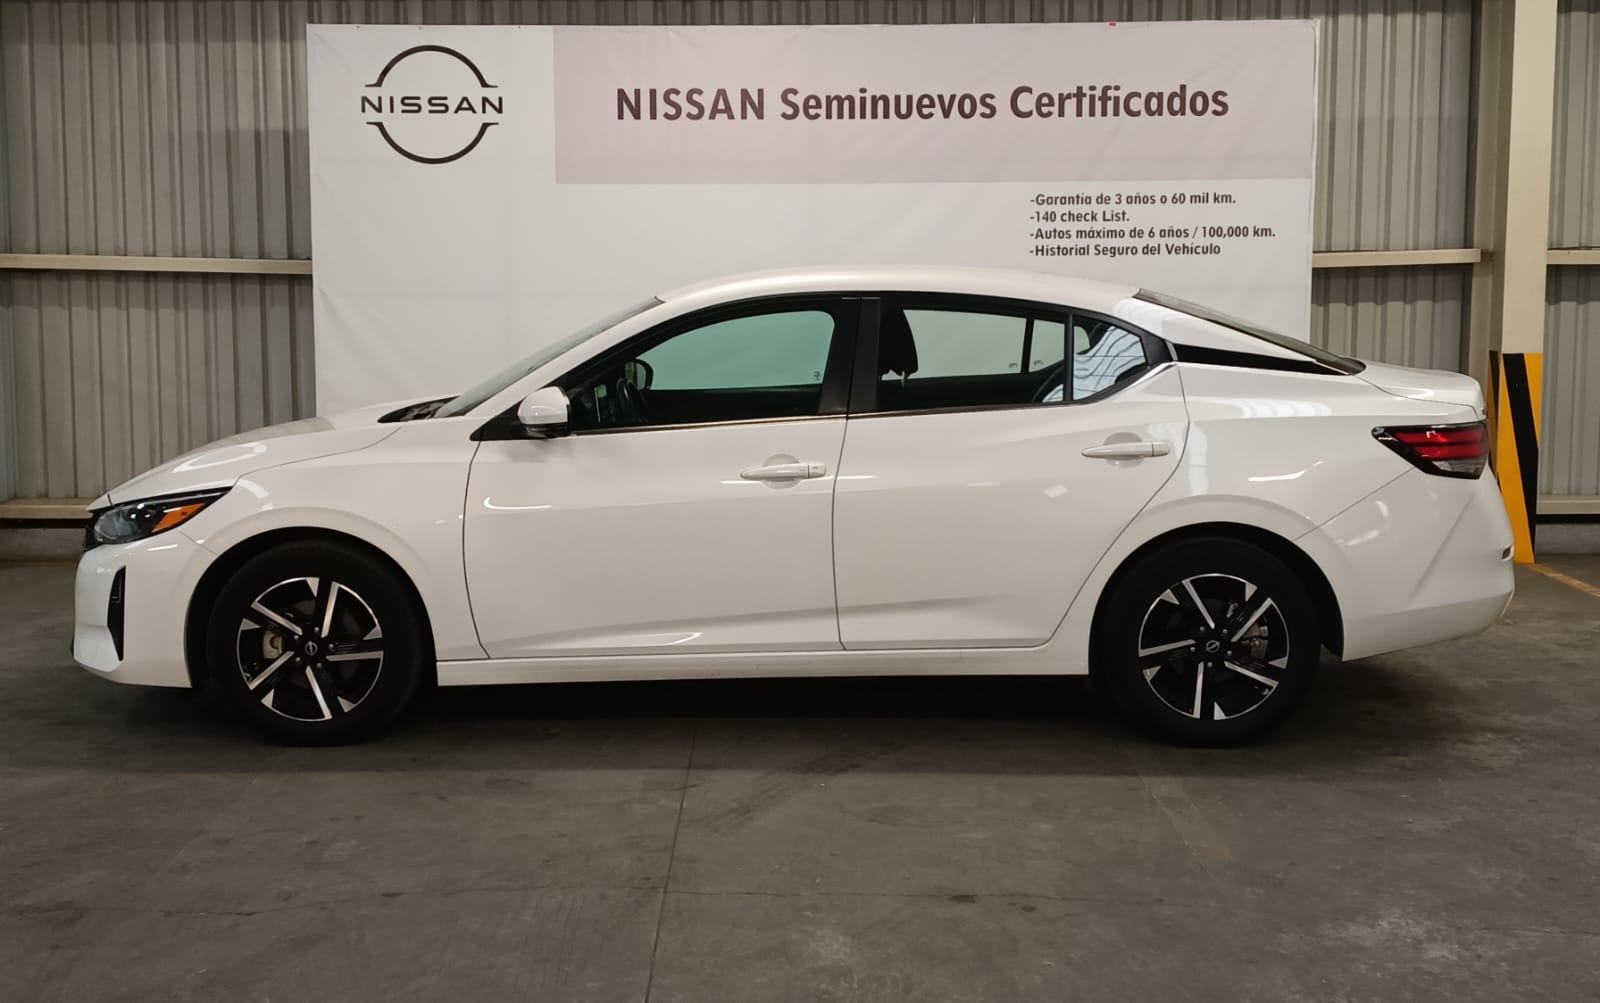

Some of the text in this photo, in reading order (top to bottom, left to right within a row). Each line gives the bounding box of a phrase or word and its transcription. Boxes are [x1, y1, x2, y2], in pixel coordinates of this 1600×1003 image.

[361, 95, 503, 115] NISSAN
[617, 83, 1228, 121] NISSAN Seminuevos Certificados
[1030, 192, 1236, 206] -Garantía de 3 años o 60 mil km.
[1030, 210, 1130, 223] -140 check List.
[1029, 225, 1276, 240] -Autos máximo de 6 años / 100,000 km.
[1029, 242, 1221, 258] -Historial Seguro del Vehículo
